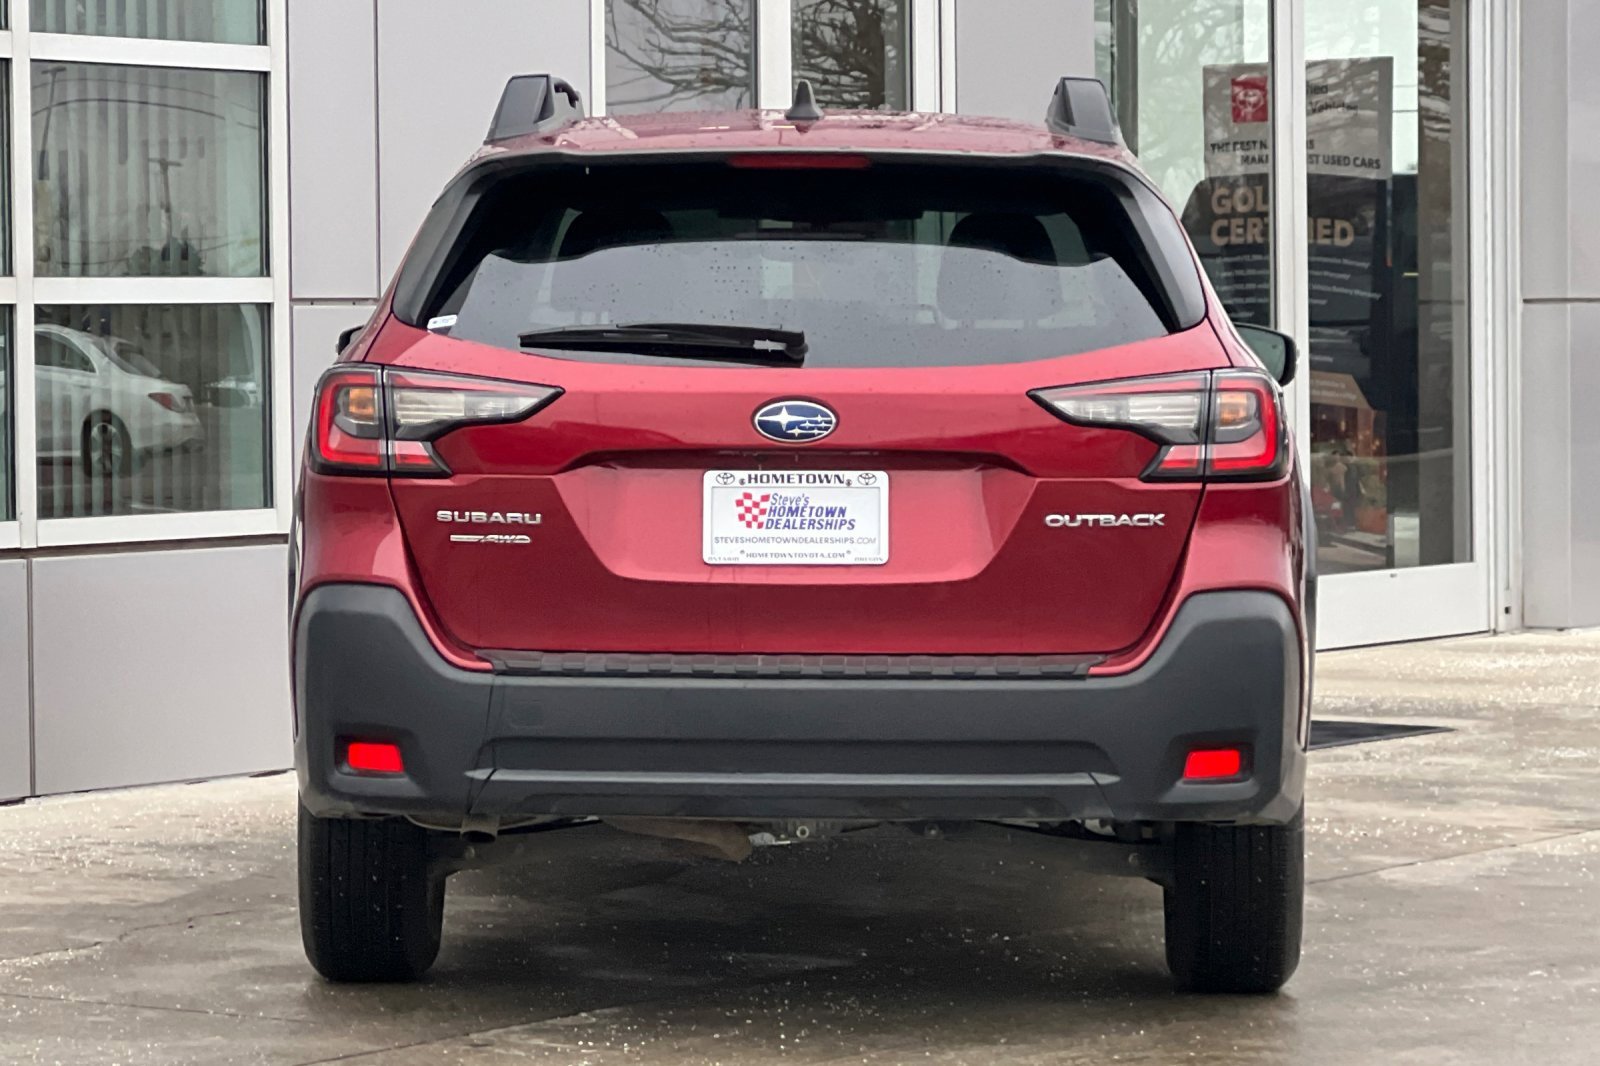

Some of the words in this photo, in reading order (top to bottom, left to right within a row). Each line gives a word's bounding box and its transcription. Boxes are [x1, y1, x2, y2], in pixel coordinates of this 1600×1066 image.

[1323, 155, 1350, 166] USED
[1353, 156, 1381, 169] CARS
[1211, 184, 1269, 215] GOL
[747, 473, 845, 485] HOMETOWN
[770, 492, 810, 507] Steve's
[436, 510, 542, 524] SUBARU
[767, 505, 847, 518] HOMETOWN
[765, 518, 856, 531] DEALERSHIPS
[1045, 513, 1166, 527] OUTBACK
[714, 536, 876, 545] STEVESHOMETOWNDEALERSHIPS.COM
